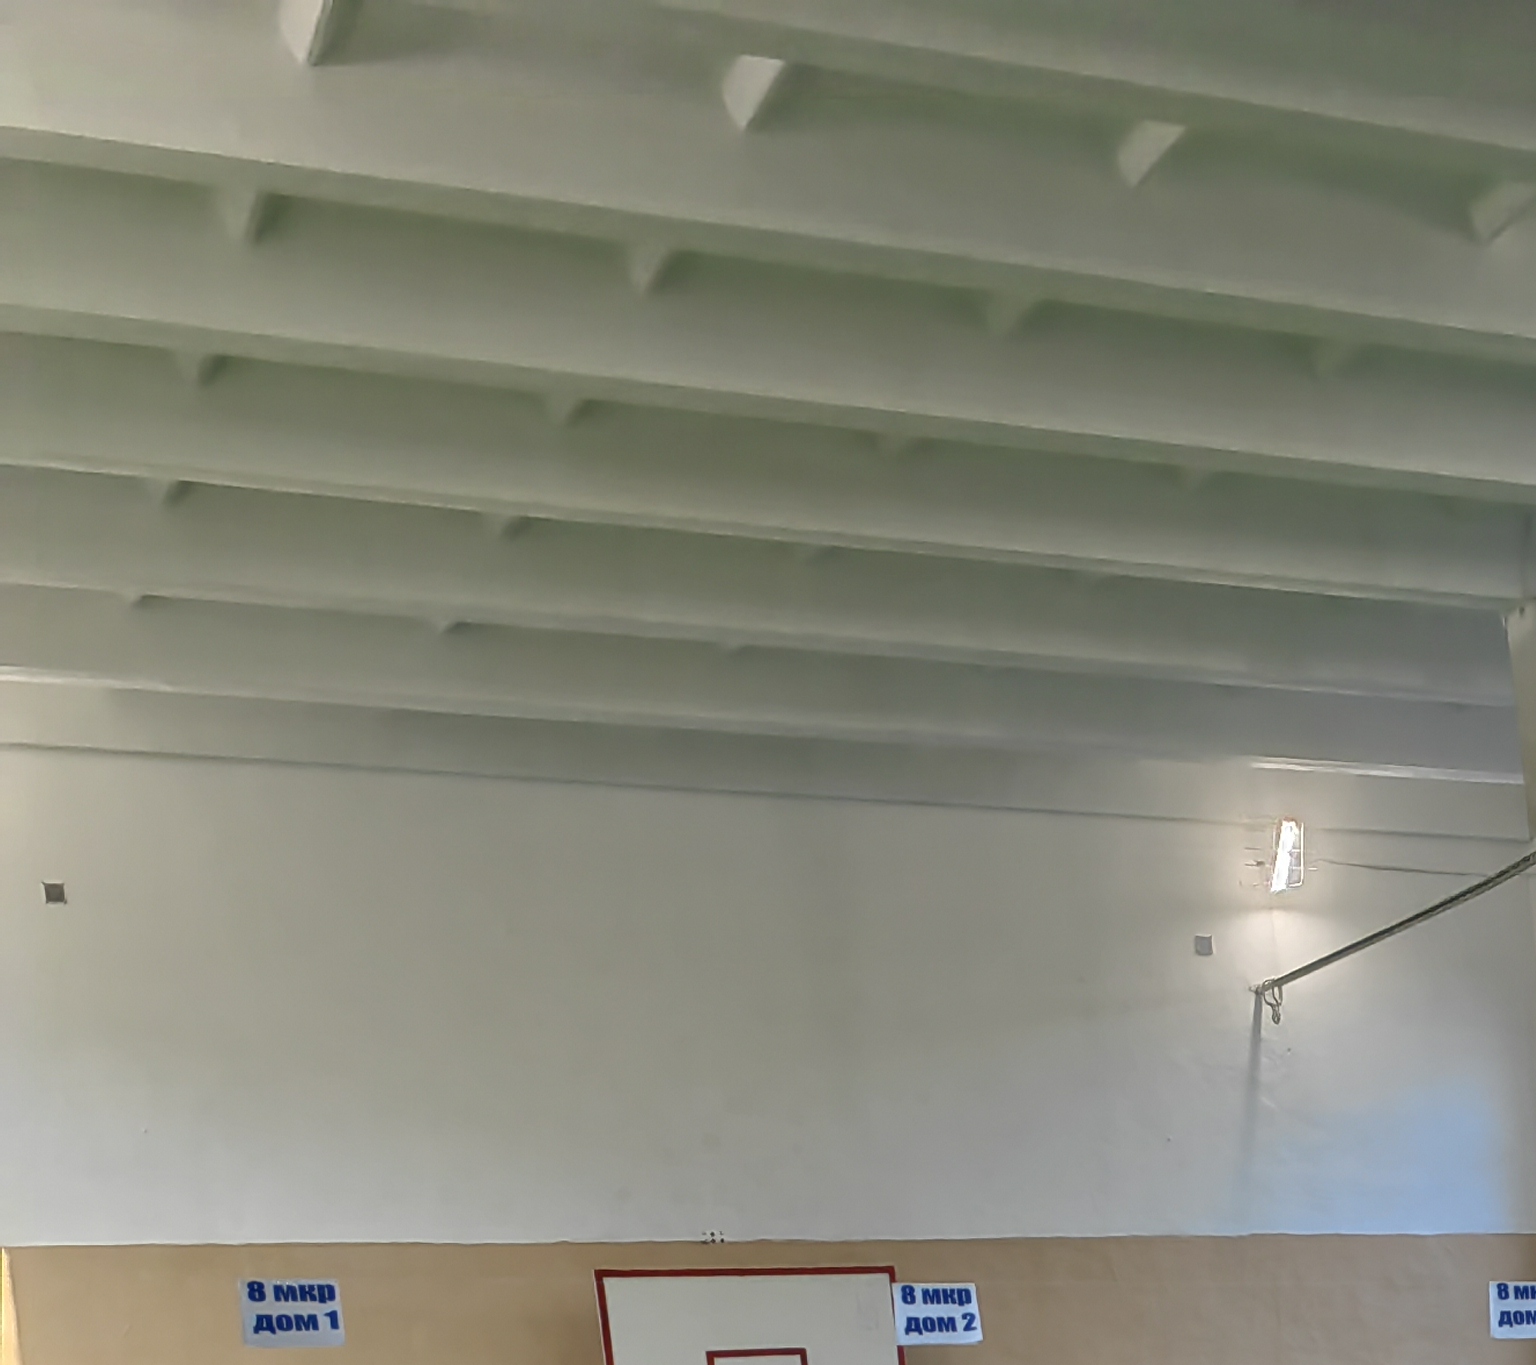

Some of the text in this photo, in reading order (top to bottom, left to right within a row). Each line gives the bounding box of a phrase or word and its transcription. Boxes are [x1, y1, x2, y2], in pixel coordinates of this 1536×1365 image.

[247, 1281, 336, 1304] 8 мкр
[901, 1285, 972, 1307] 8 мкр
[1496, 1283, 1510, 1300] 8
[253, 1310, 340, 1335] дом 1
[905, 1312, 977, 1336] дом 2
